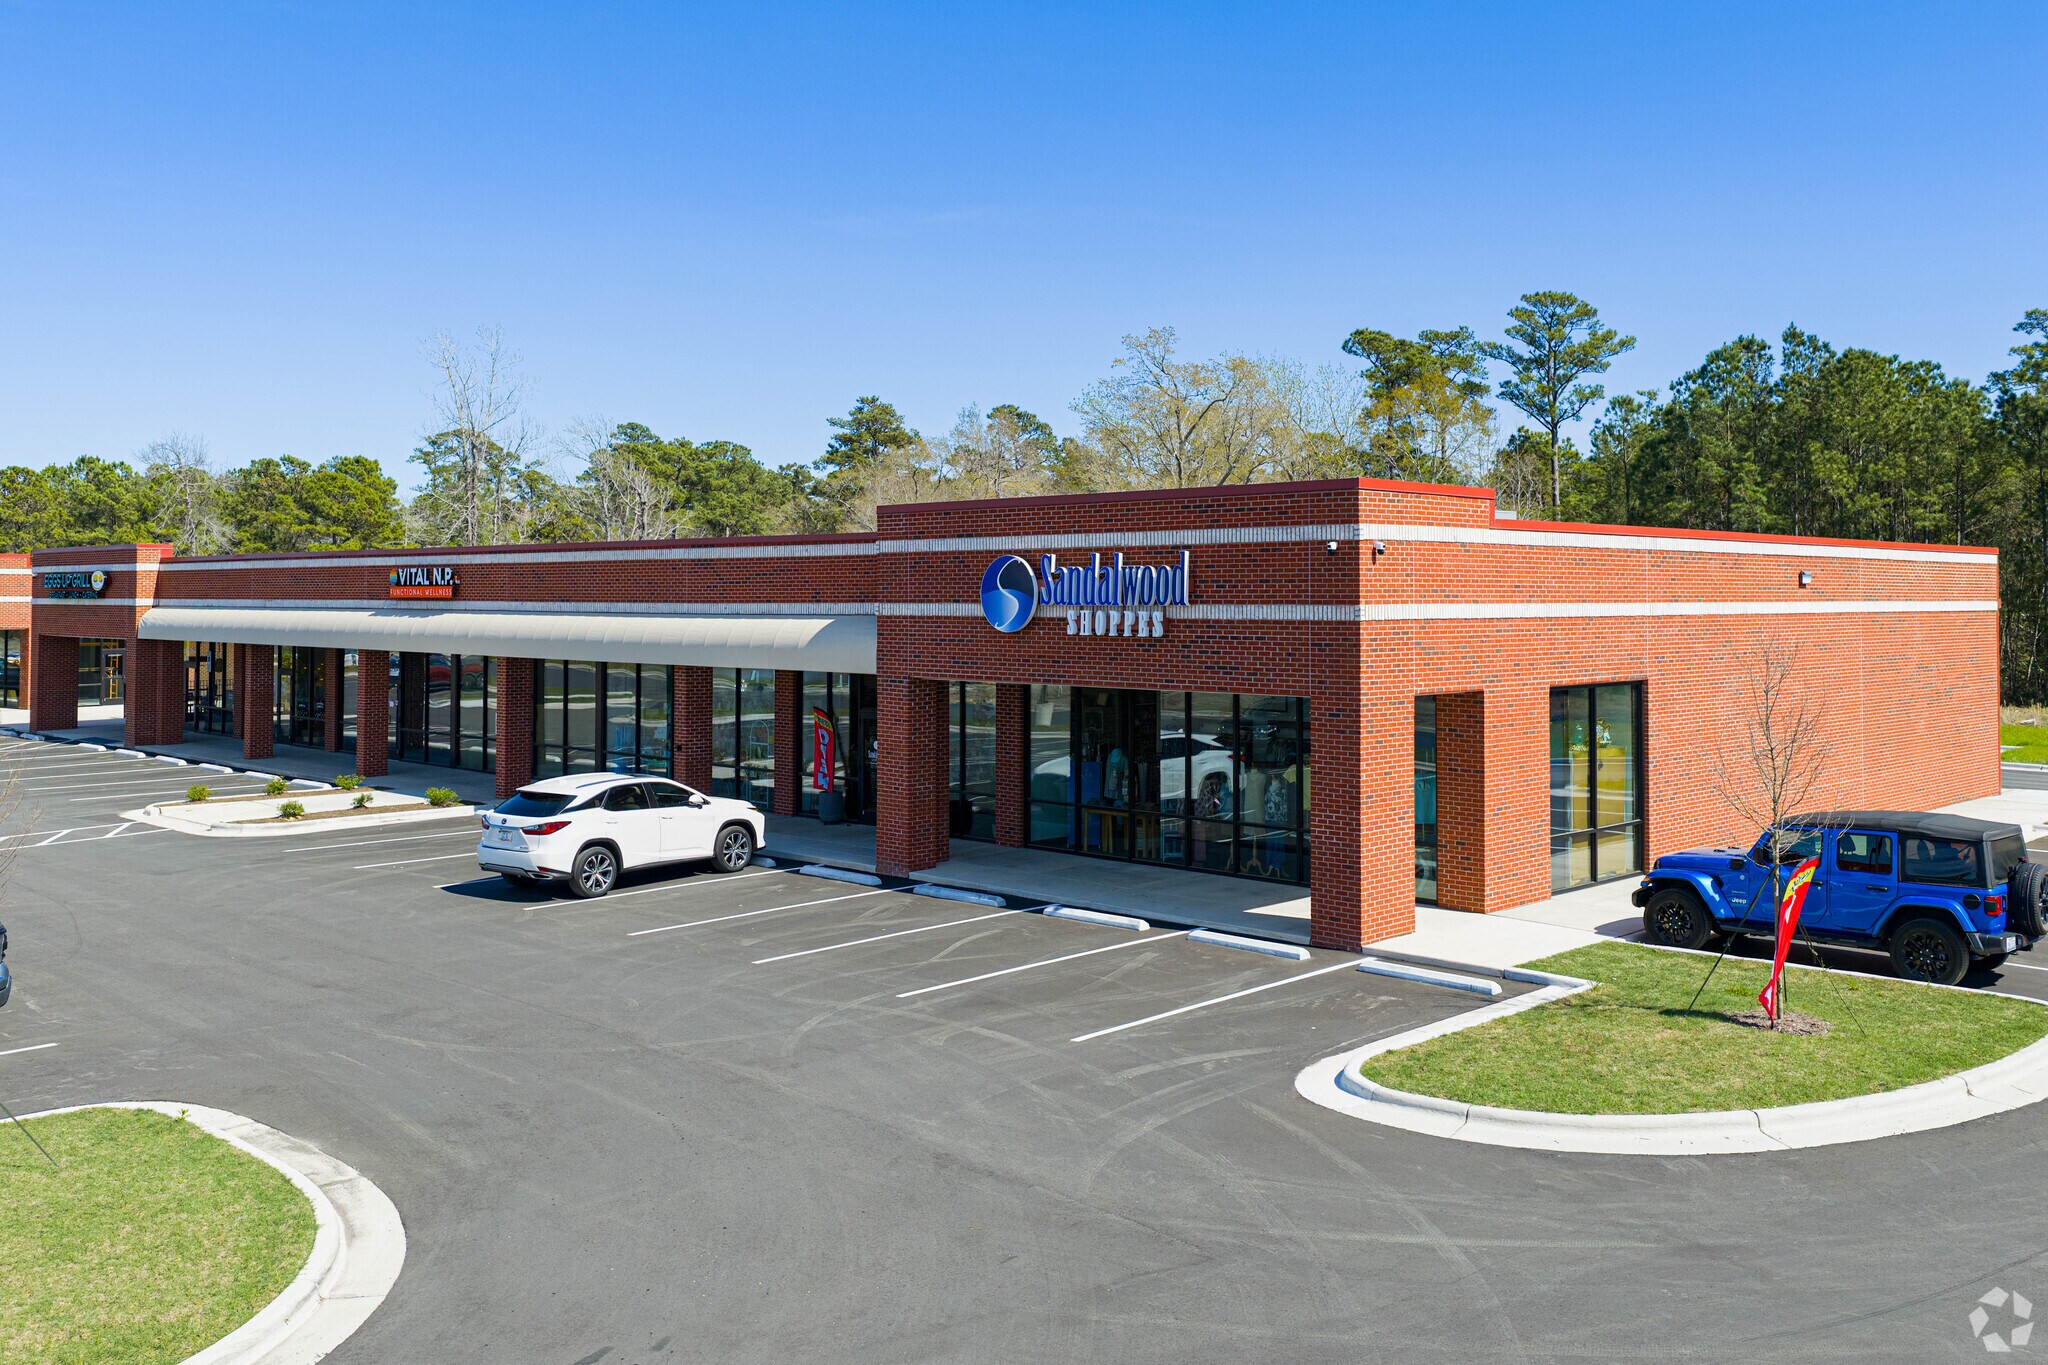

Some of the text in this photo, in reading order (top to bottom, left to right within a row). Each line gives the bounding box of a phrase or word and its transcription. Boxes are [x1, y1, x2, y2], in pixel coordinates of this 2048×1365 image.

[44, 573, 90, 588] EGGS UP GRILL
[398, 568, 454, 585] VITAL N.P.
[1040, 551, 1190, 606] Sandalwood
[425, 588, 452, 596] WELLNESS
[1067, 610, 1164, 637] SHOPPES
